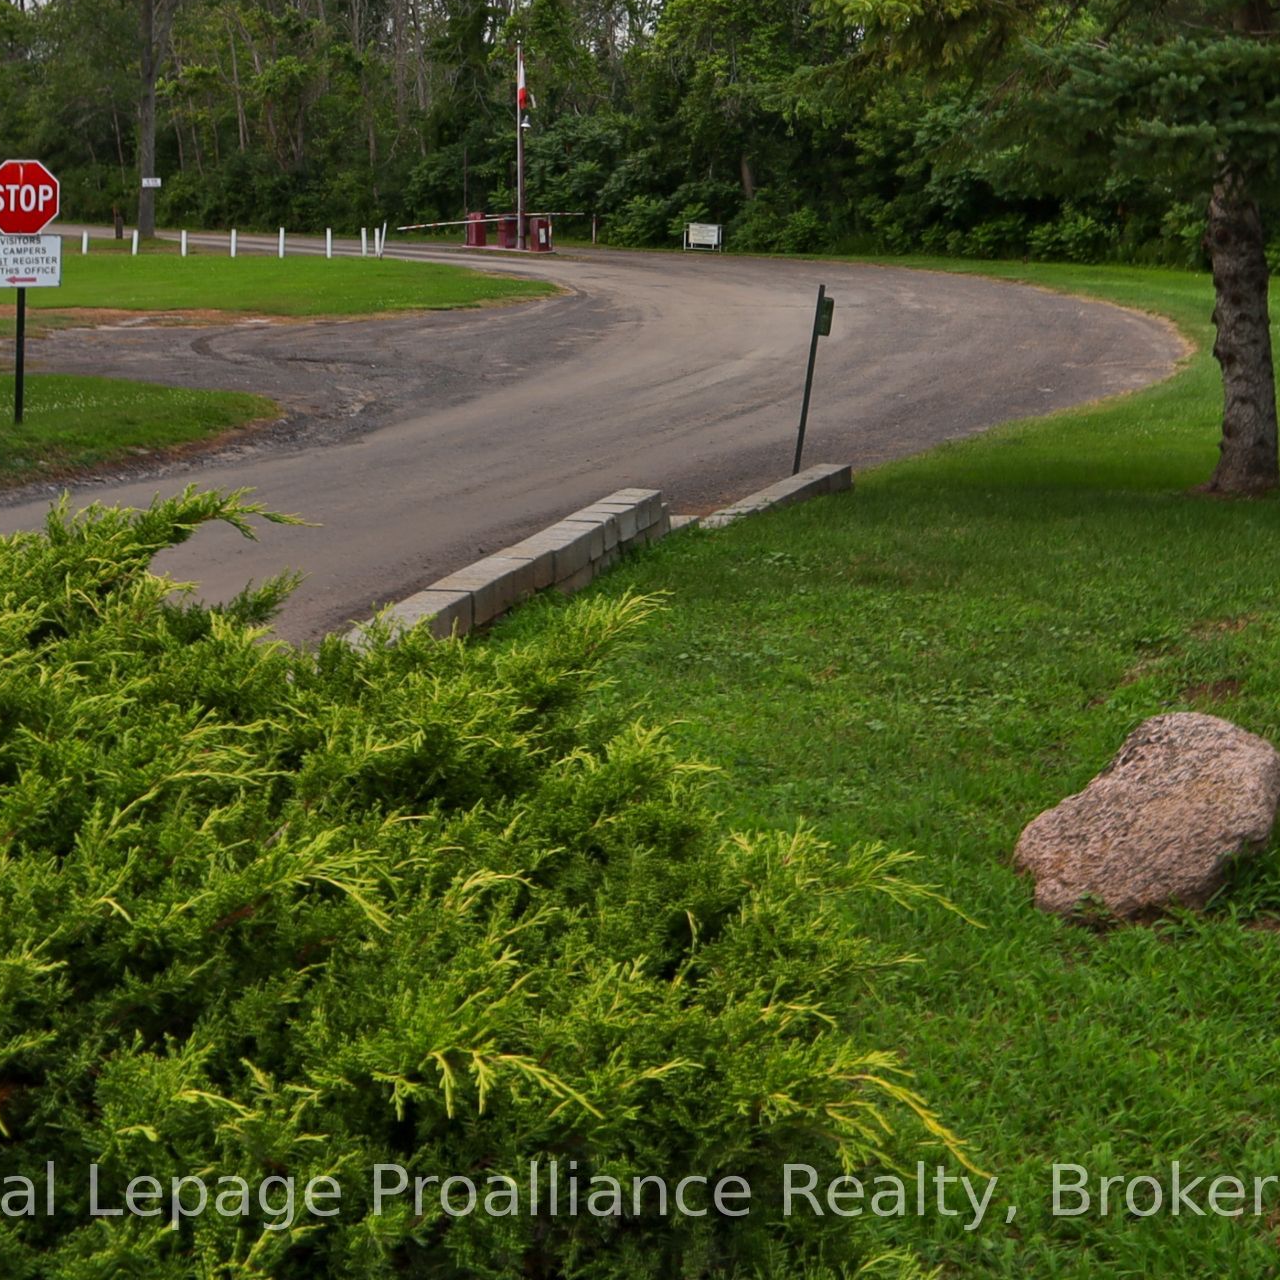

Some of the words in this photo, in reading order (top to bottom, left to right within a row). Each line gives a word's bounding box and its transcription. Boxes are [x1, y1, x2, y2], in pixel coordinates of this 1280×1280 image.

[0, 236, 42, 245] VISITORS
[2, 247, 47, 256] CAMPERS
[12, 256, 58, 265] REGISTER
[0, 267, 20, 275] THIS
[24, 266, 56, 275] OFFICE
